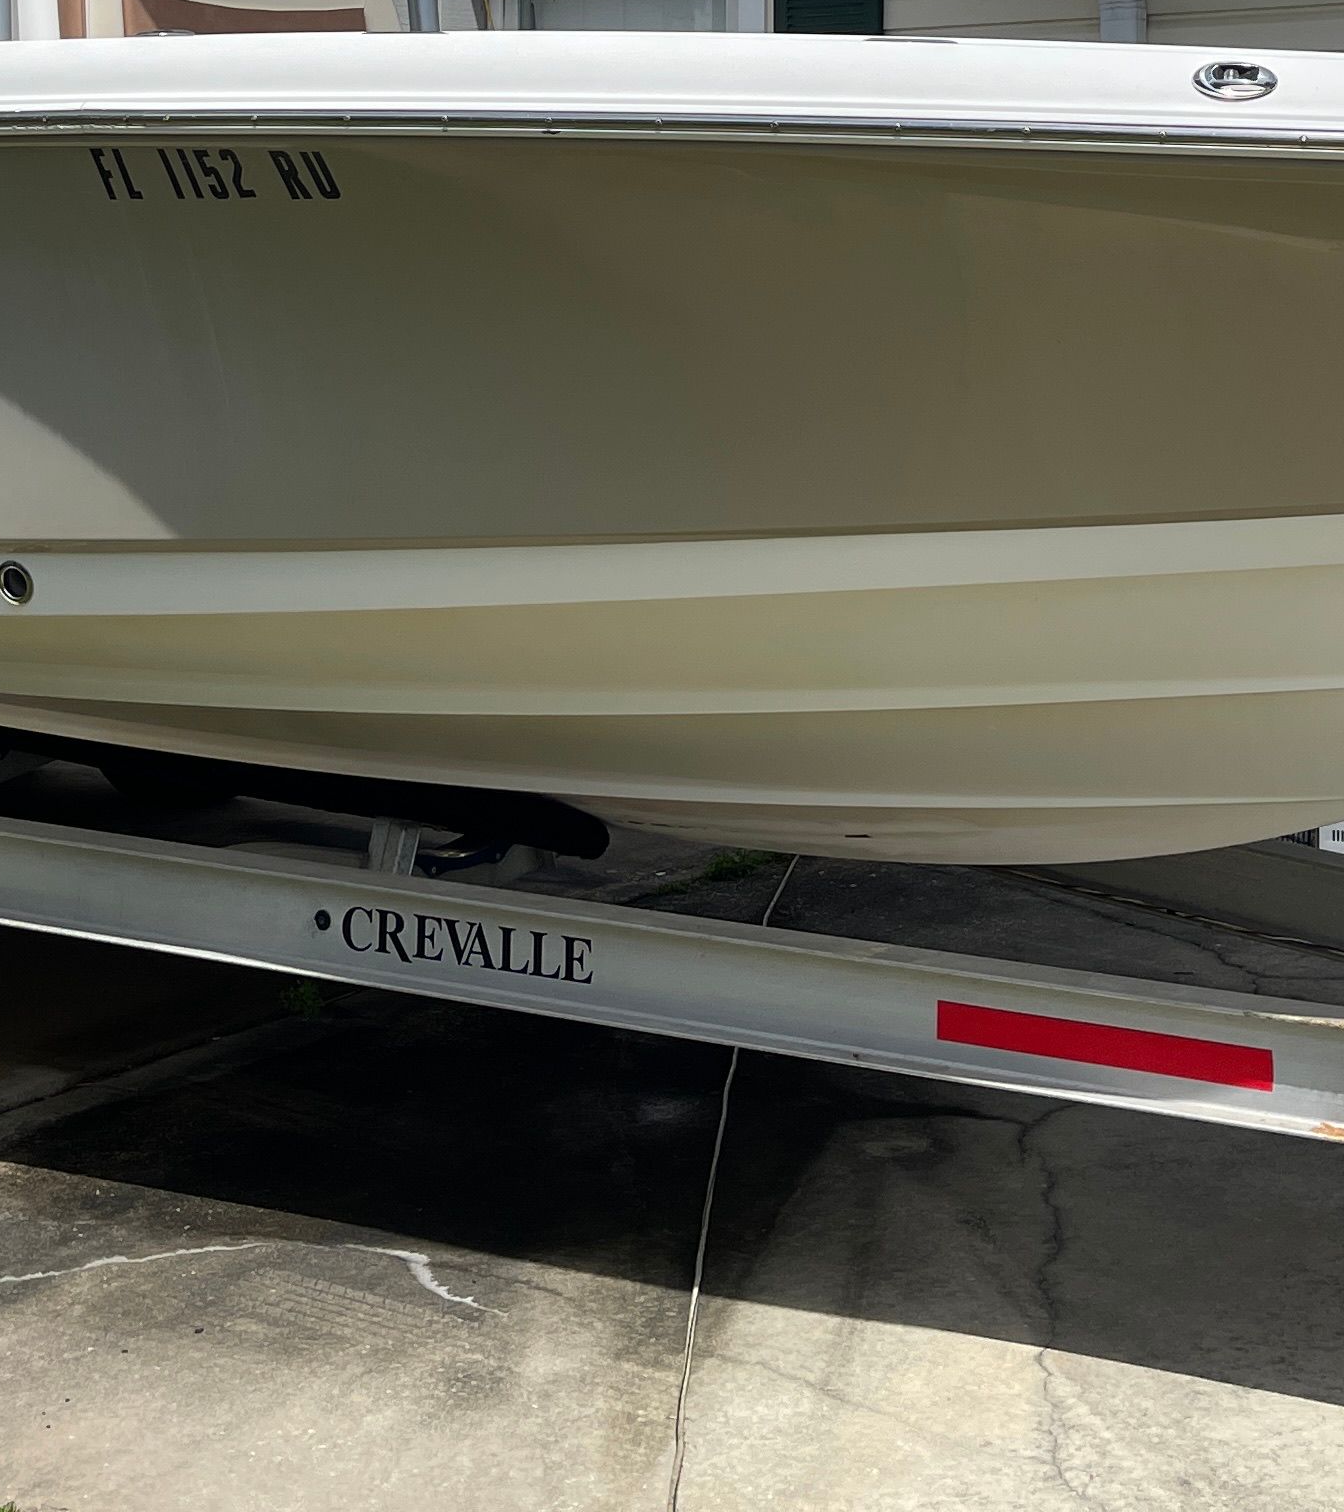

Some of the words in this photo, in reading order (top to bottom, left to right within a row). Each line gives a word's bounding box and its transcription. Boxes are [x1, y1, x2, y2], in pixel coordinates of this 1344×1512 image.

[89, 148, 144, 200] FL
[156, 148, 257, 200] 1152
[267, 150, 341, 200] RU
[342, 906, 594, 984] CREVALLE
